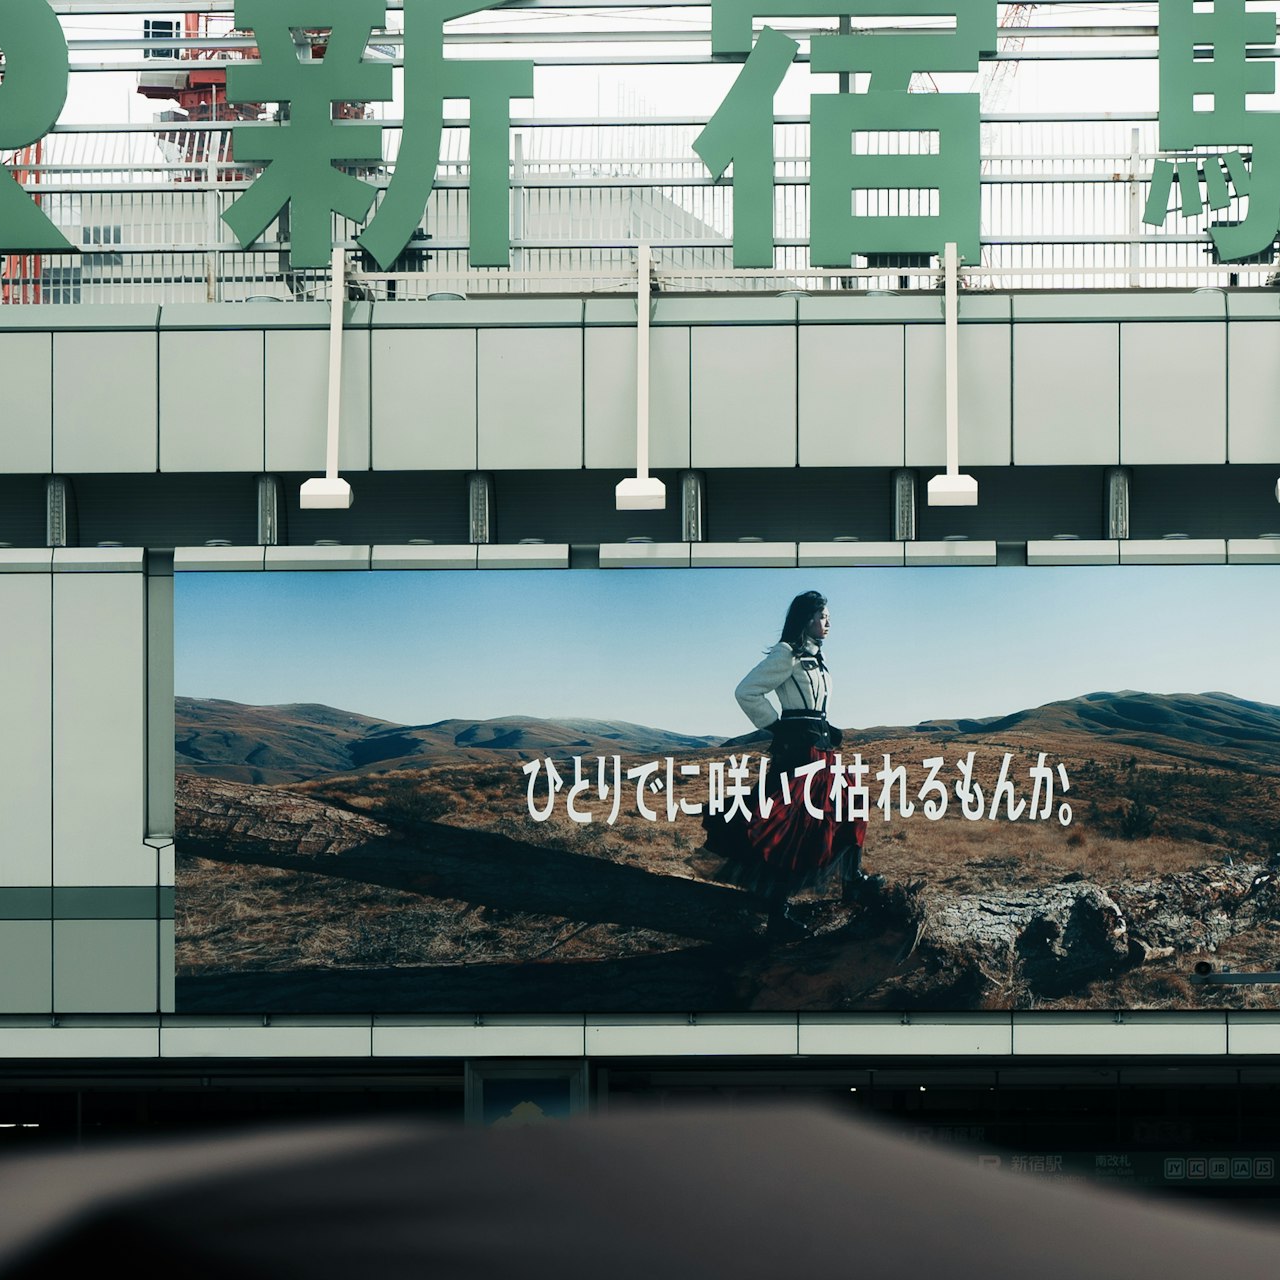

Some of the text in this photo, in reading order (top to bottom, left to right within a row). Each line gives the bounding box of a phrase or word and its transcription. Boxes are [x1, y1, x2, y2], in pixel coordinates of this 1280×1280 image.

[522, 752, 1075, 827] ひとりでに咲いて枯れるもんか。
[1168, 1162, 1270, 1174] JY JC JB JA JS
